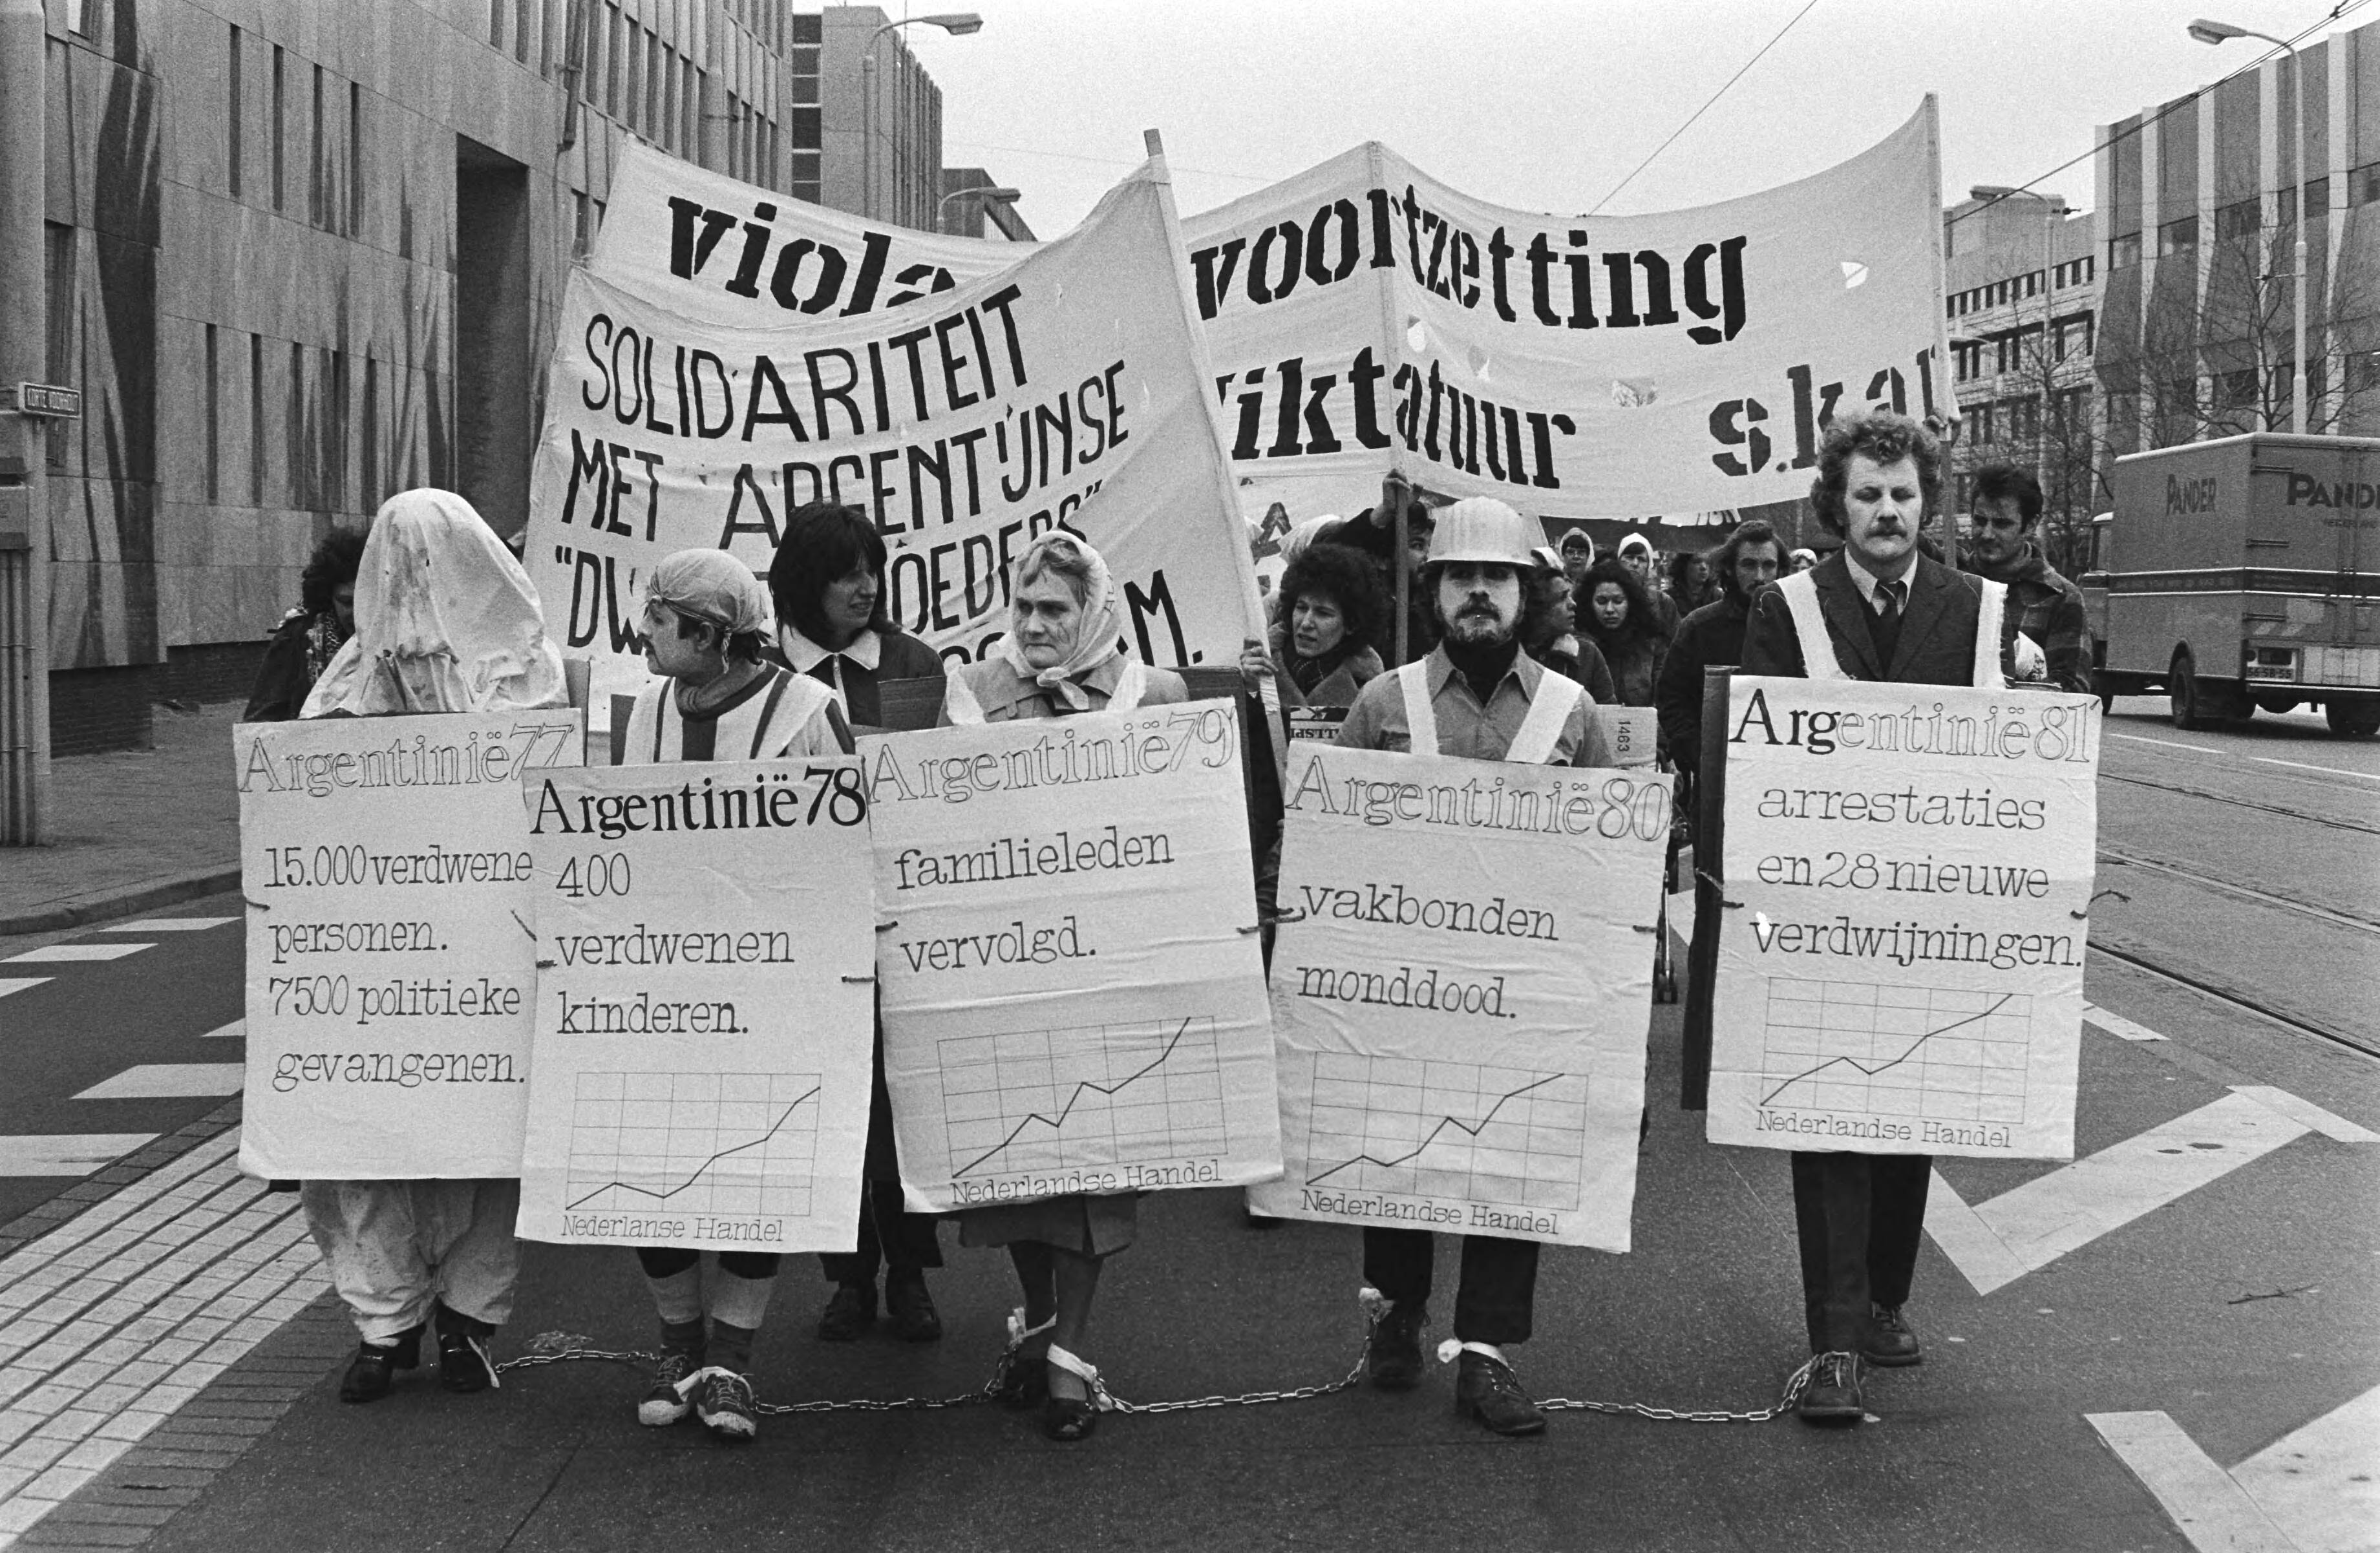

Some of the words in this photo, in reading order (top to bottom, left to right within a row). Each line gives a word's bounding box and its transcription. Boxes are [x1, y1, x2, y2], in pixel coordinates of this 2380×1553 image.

[1190, 184, 1747, 344] voortzetting
[581, 284, 1028, 443] SOLIDARITEIT
[1216, 346, 1577, 488] iktatuur
[561, 429, 664, 542] MET
[2167, 474, 2216, 516] PANDER
[2287, 472, 2380, 510] PAND
[1617, 721, 1631, 752] 1463
[1757, 785, 2046, 830] arrestaties
[556, 852, 631, 898] 400
[895, 826, 1174, 891] familieleden
[1300, 883, 1559, 940] vakbonden
[268, 920, 449, 964] personen.
[556, 924, 795, 965] verdwenen
[900, 916, 1097, 974] vervolgd.
[1750, 916, 2083, 970] verdwijningen.
[269, 975, 350, 1016] 7500
[357, 978, 521, 1025] politieke
[557, 991, 749, 1035] kinderen.
[1296, 966, 1516, 1019] monddood.
[273, 1051, 526, 1092] gevangenen.
[1756, 1110, 1912, 1141] Nederlandse
[1920, 1122, 2013, 1148] Handel
[951, 1170, 1116, 1205] Nederlandse
[1123, 1159, 1224, 1190] Handel
[561, 1215, 685, 1239] Nederlanse
[694, 1218, 784, 1242] Handel
[1301, 1189, 1463, 1224] Nederlandse
[1468, 1206, 1559, 1235] Handel
